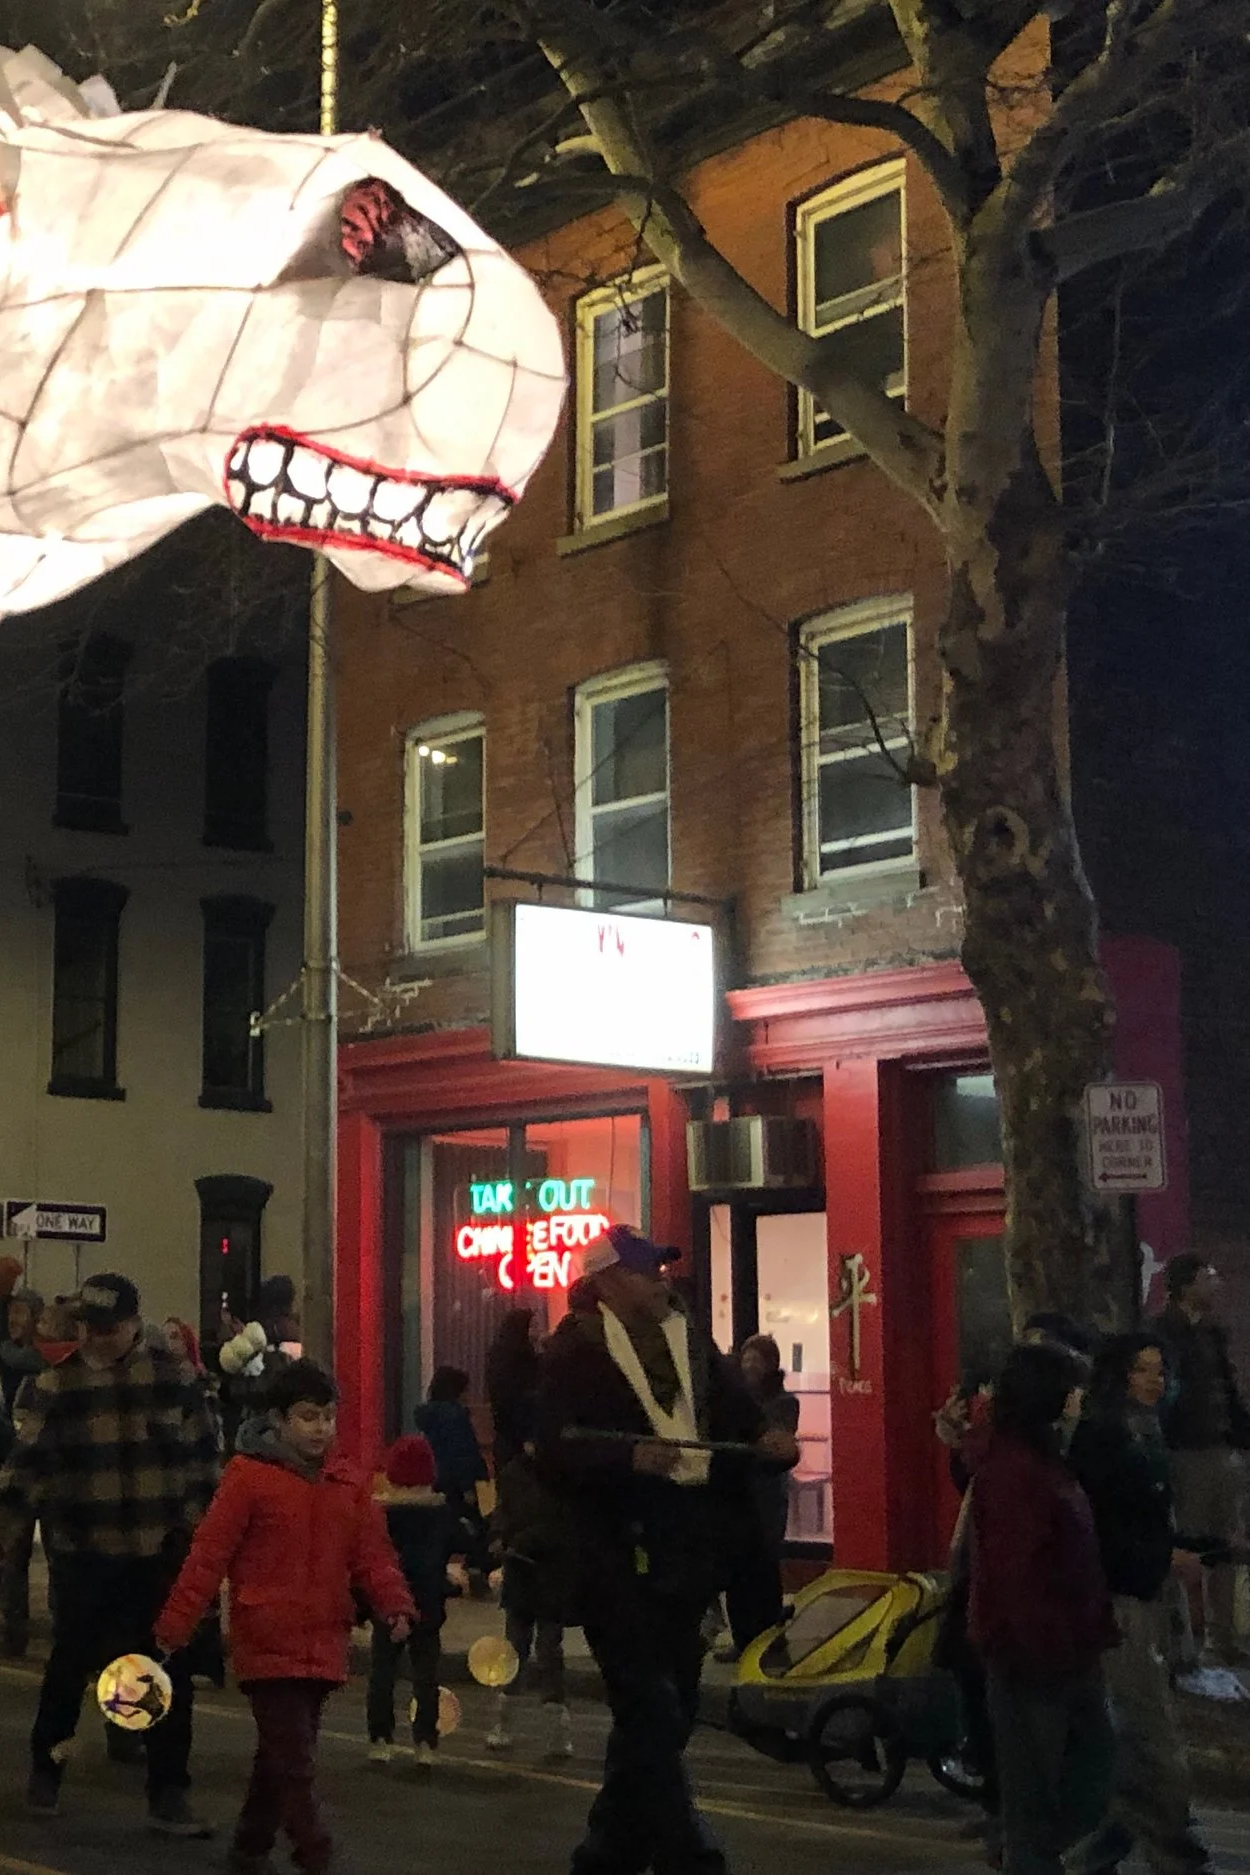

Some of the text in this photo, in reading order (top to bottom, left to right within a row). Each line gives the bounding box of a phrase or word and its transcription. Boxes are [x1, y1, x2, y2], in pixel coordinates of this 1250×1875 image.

[1110, 1090, 1137, 1109] NO
[1093, 1113, 1158, 1135] PARKING
[470, 1178, 596, 1214] TAK OUT
[36, 1212, 63, 1230] ONE
[68, 1214, 95, 1231] WAY
[457, 1219, 549, 1259] CHINE
